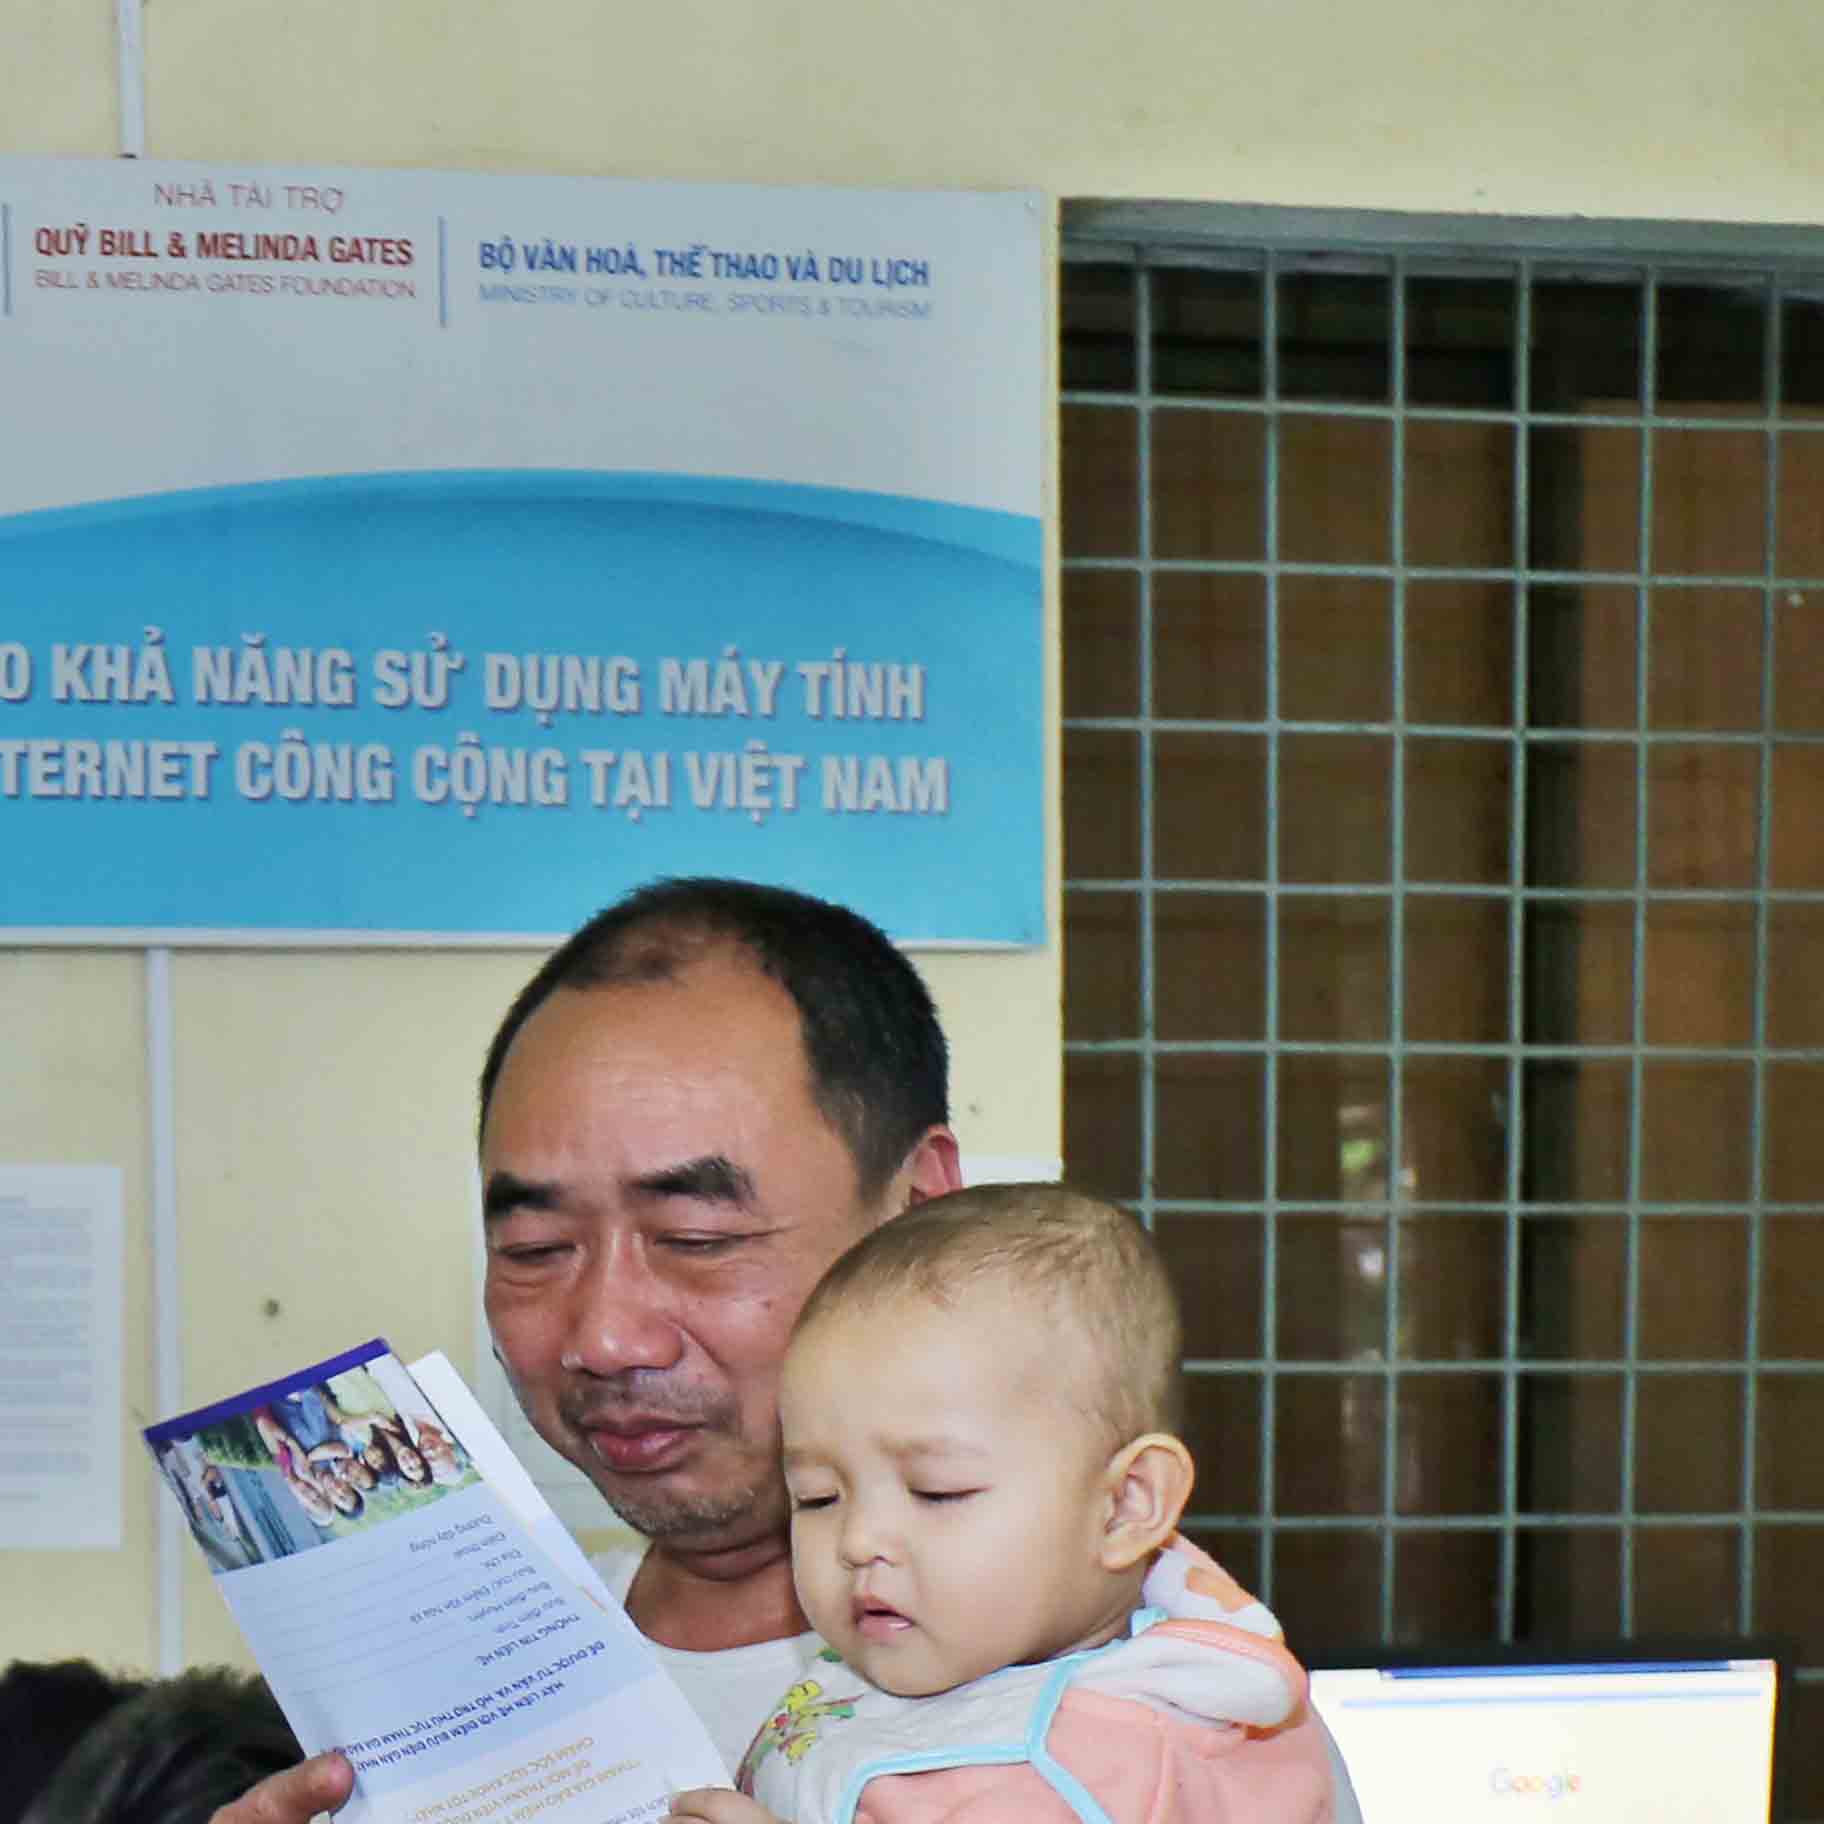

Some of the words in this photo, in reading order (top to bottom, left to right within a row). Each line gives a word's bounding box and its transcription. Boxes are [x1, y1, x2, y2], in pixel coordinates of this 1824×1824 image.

[153, 178, 217, 208] NHÀ
[222, 179, 273, 209] TÀI
[281, 185, 345, 217] TRỢ
[35, 222, 90, 257] QUỸ
[99, 229, 160, 259] BILL
[167, 231, 188, 259] &
[196, 231, 321, 262] MELINDA
[328, 236, 414, 267] GATES
[479, 236, 517, 276] BỘ
[521, 238, 579, 275] VĂN
[653, 244, 710, 280] THỂ
[711, 253, 782, 283] THAO
[785, 249, 822, 284] VÀ
[828, 257, 866, 287] DU
[871, 258, 930, 291] LỊCH
[34, 268, 80, 290] BILL
[86, 271, 101, 289] &
[104, 271, 202, 294] MELINDA
[205, 272, 277, 296] GATES
[279, 272, 417, 302] FOUNDATION
[51, 626, 174, 702] KHẢ
[192, 633, 356, 705] NĂNG
[373, 633, 466, 708] SỬ
[483, 652, 642, 724] DỤNG
[658, 646, 785, 717] MÁY
[795, 649, 928, 720] TÍNH
[235, 729, 394, 801] CÔNG
[411, 736, 568, 817] CỘNG
[578, 748, 673, 822] TẠI
[683, 741, 809, 824] VIỆT
[820, 752, 952, 817] NAM
[517, 1633, 541, 1646] TIN
[536, 1613, 581, 1638] THÔNG
[475, 1652, 496, 1667] HỆ
[493, 1640, 520, 1659] LIÊN
[1489, 1766, 1583, 1799] Google
